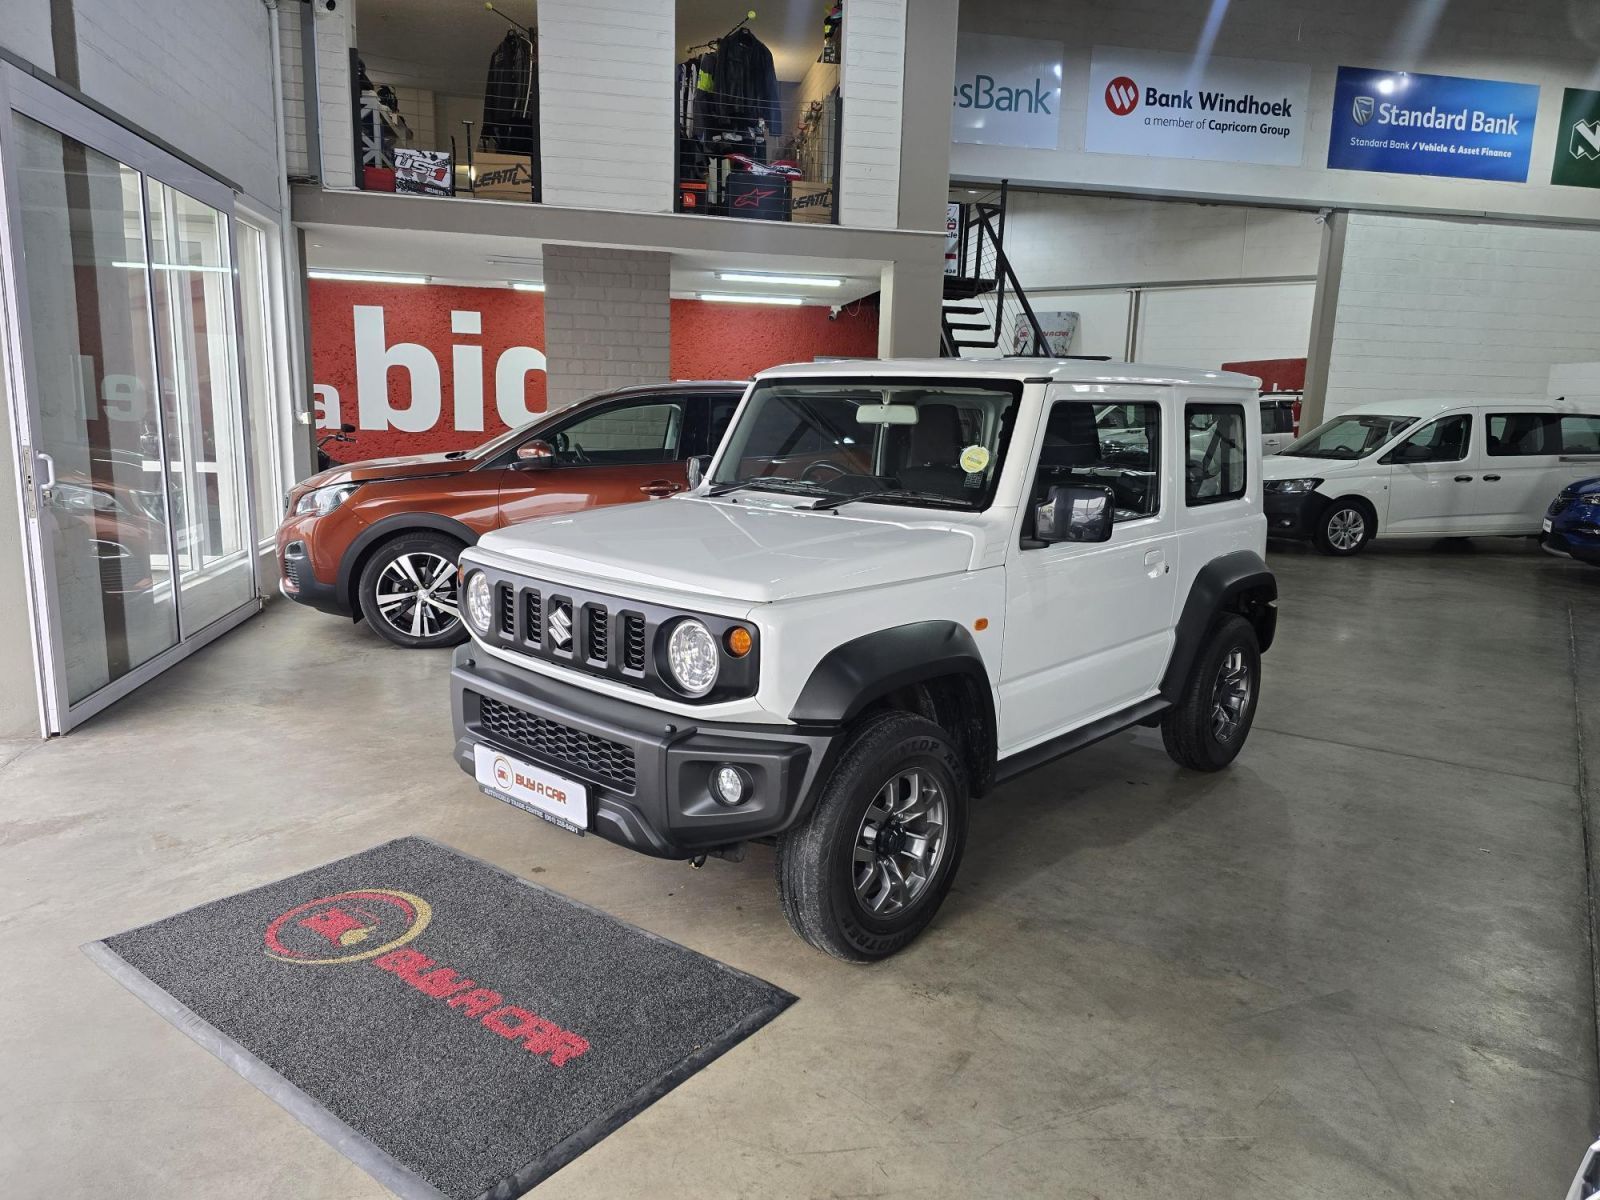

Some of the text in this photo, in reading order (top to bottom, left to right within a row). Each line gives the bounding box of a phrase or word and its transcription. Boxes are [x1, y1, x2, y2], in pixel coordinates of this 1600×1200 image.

[953, 74, 1052, 115] sBank
[1145, 87, 1292, 117] Bank Windhoek
[1153, 117, 1194, 129] member
[1196, 119, 1207, 129] of
[1208, 119, 1257, 133] Capricorn
[1259, 124, 1290, 138] Group
[1378, 103, 1520, 136] Standard Bank
[1350, 137, 1388, 149] Standard
[1389, 139, 1410, 150] Bank
[1419, 142, 1448, 154] Vehicle
[1449, 145, 1456, 154] &
[1457, 146, 1480, 156] Asset
[1481, 147, 1512, 158] Finance
[515, 772, 567, 805] BUY A CAR
[373, 948, 475, 999] BUY
[482, 1004, 590, 1068] CAR
